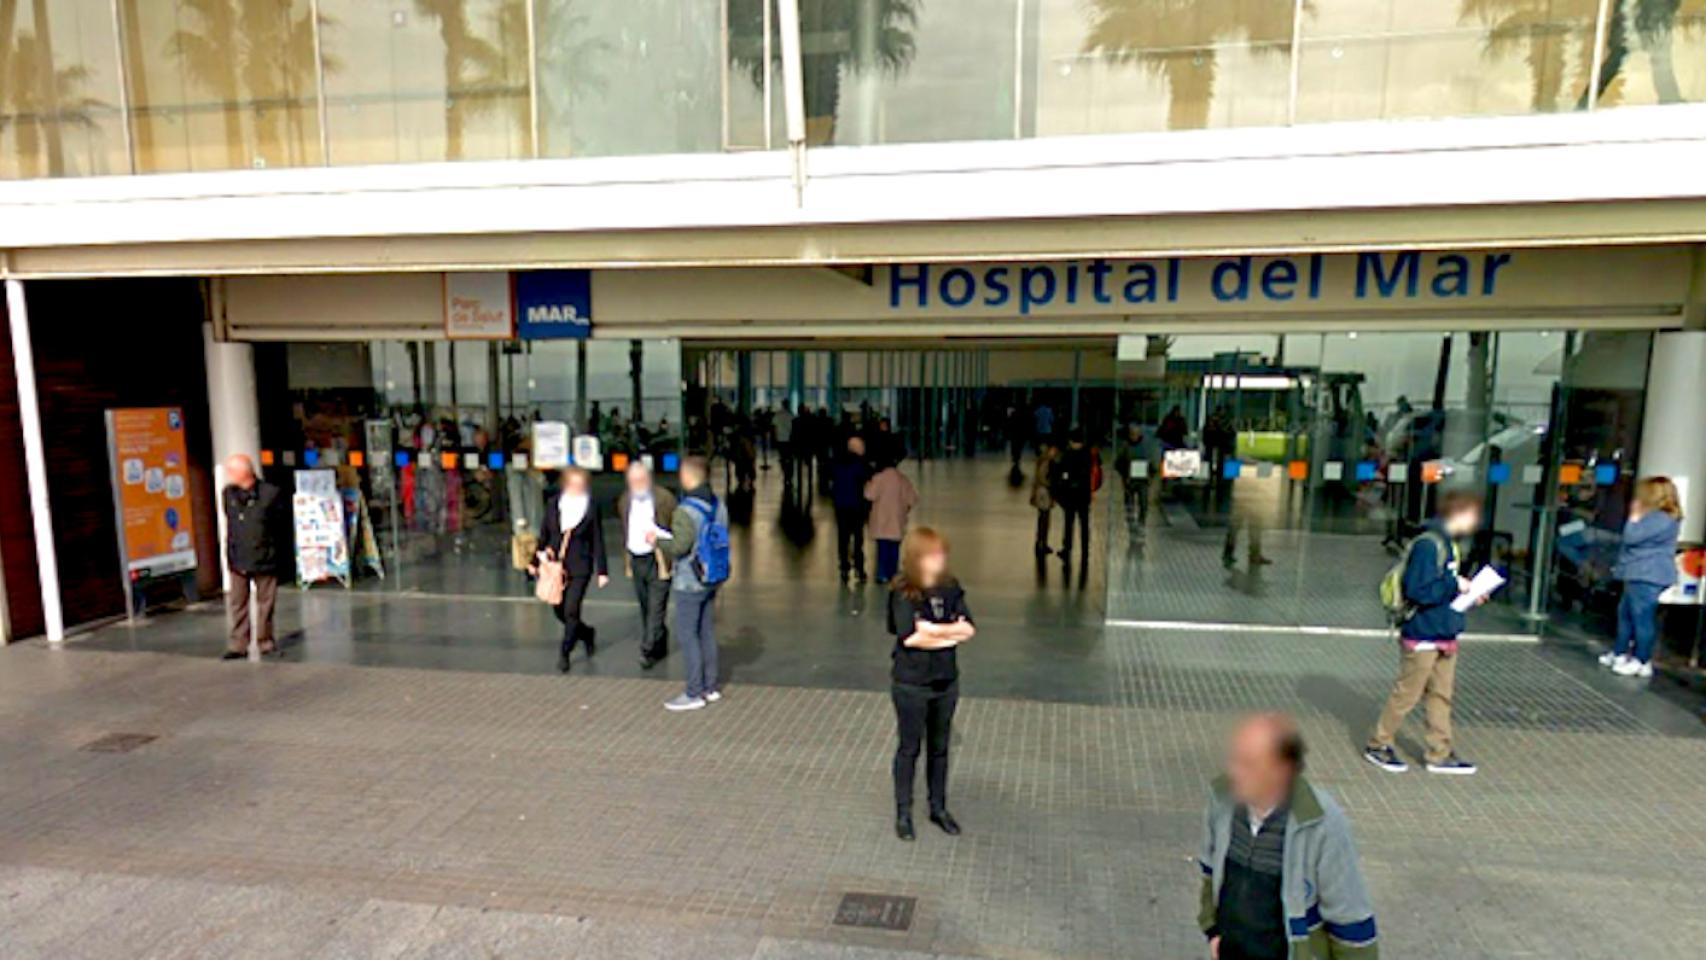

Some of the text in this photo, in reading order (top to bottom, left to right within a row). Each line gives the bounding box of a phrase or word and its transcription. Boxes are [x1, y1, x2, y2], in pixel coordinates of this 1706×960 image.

[889, 251, 1511, 315] Hospital del Mar
[526, 305, 577, 324] MAR
